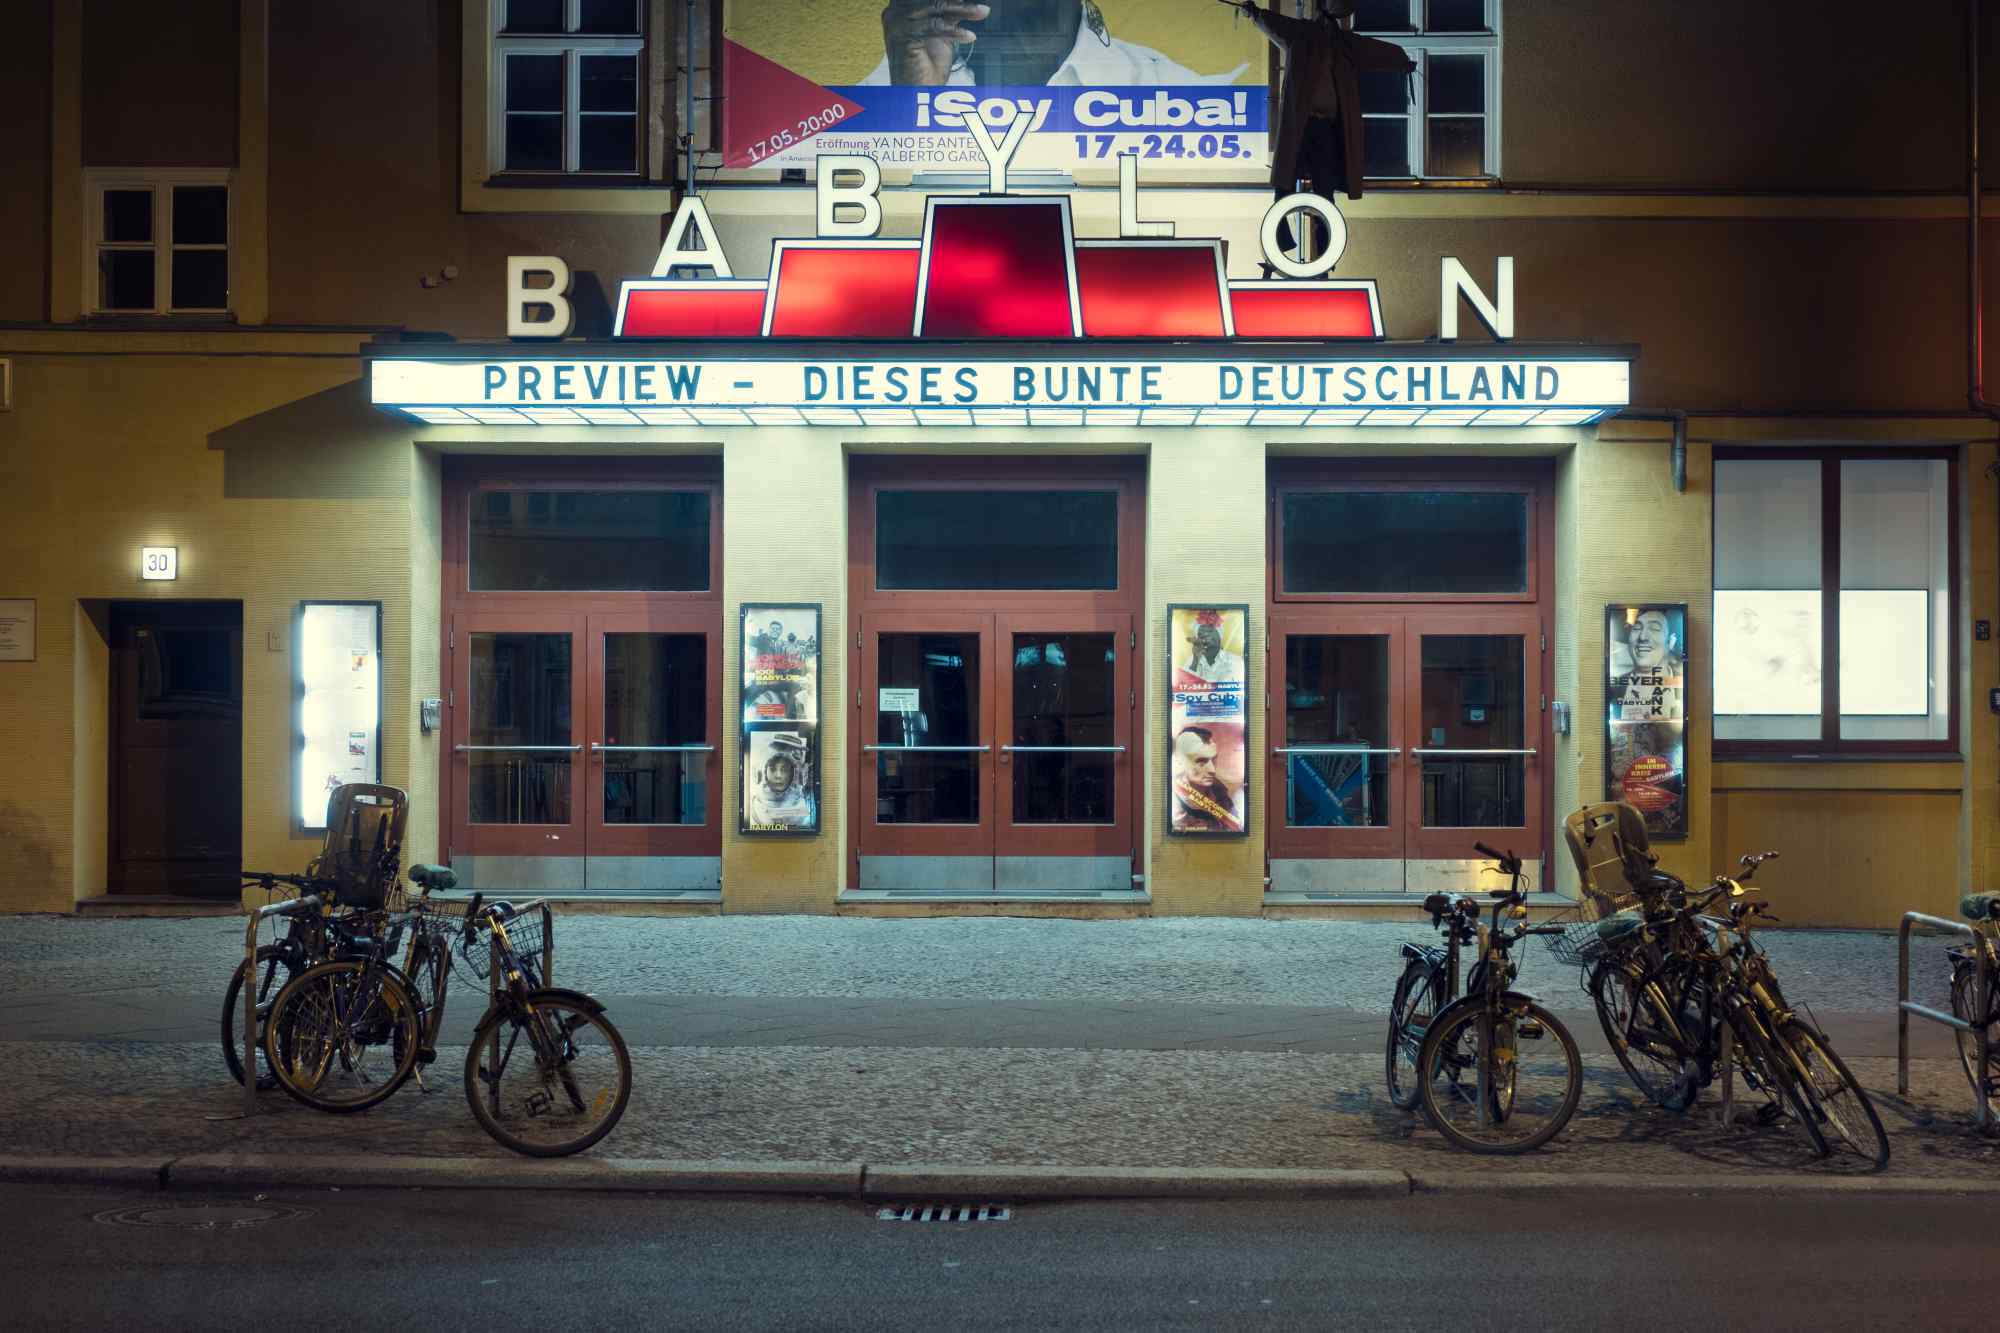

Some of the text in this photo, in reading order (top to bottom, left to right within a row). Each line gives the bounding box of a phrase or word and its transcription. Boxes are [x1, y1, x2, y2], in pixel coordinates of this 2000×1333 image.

[1074, 90, 1248, 127] Cuba!
[748, 103, 845, 162] 17.05. 20:00
[816, 137, 979, 151] Eröffnung YA NO ES ANTE
[881, 150, 945, 162] ALBERTO
[506, 111, 1515, 339] BABYLON
[484, 365, 701, 400] PREVIEW
[803, 365, 977, 402] DIESES
[1013, 365, 1161, 401] BUNTE
[1219, 362, 1558, 401] DEUTSCHLAND
[148, 553, 168, 572] 30
